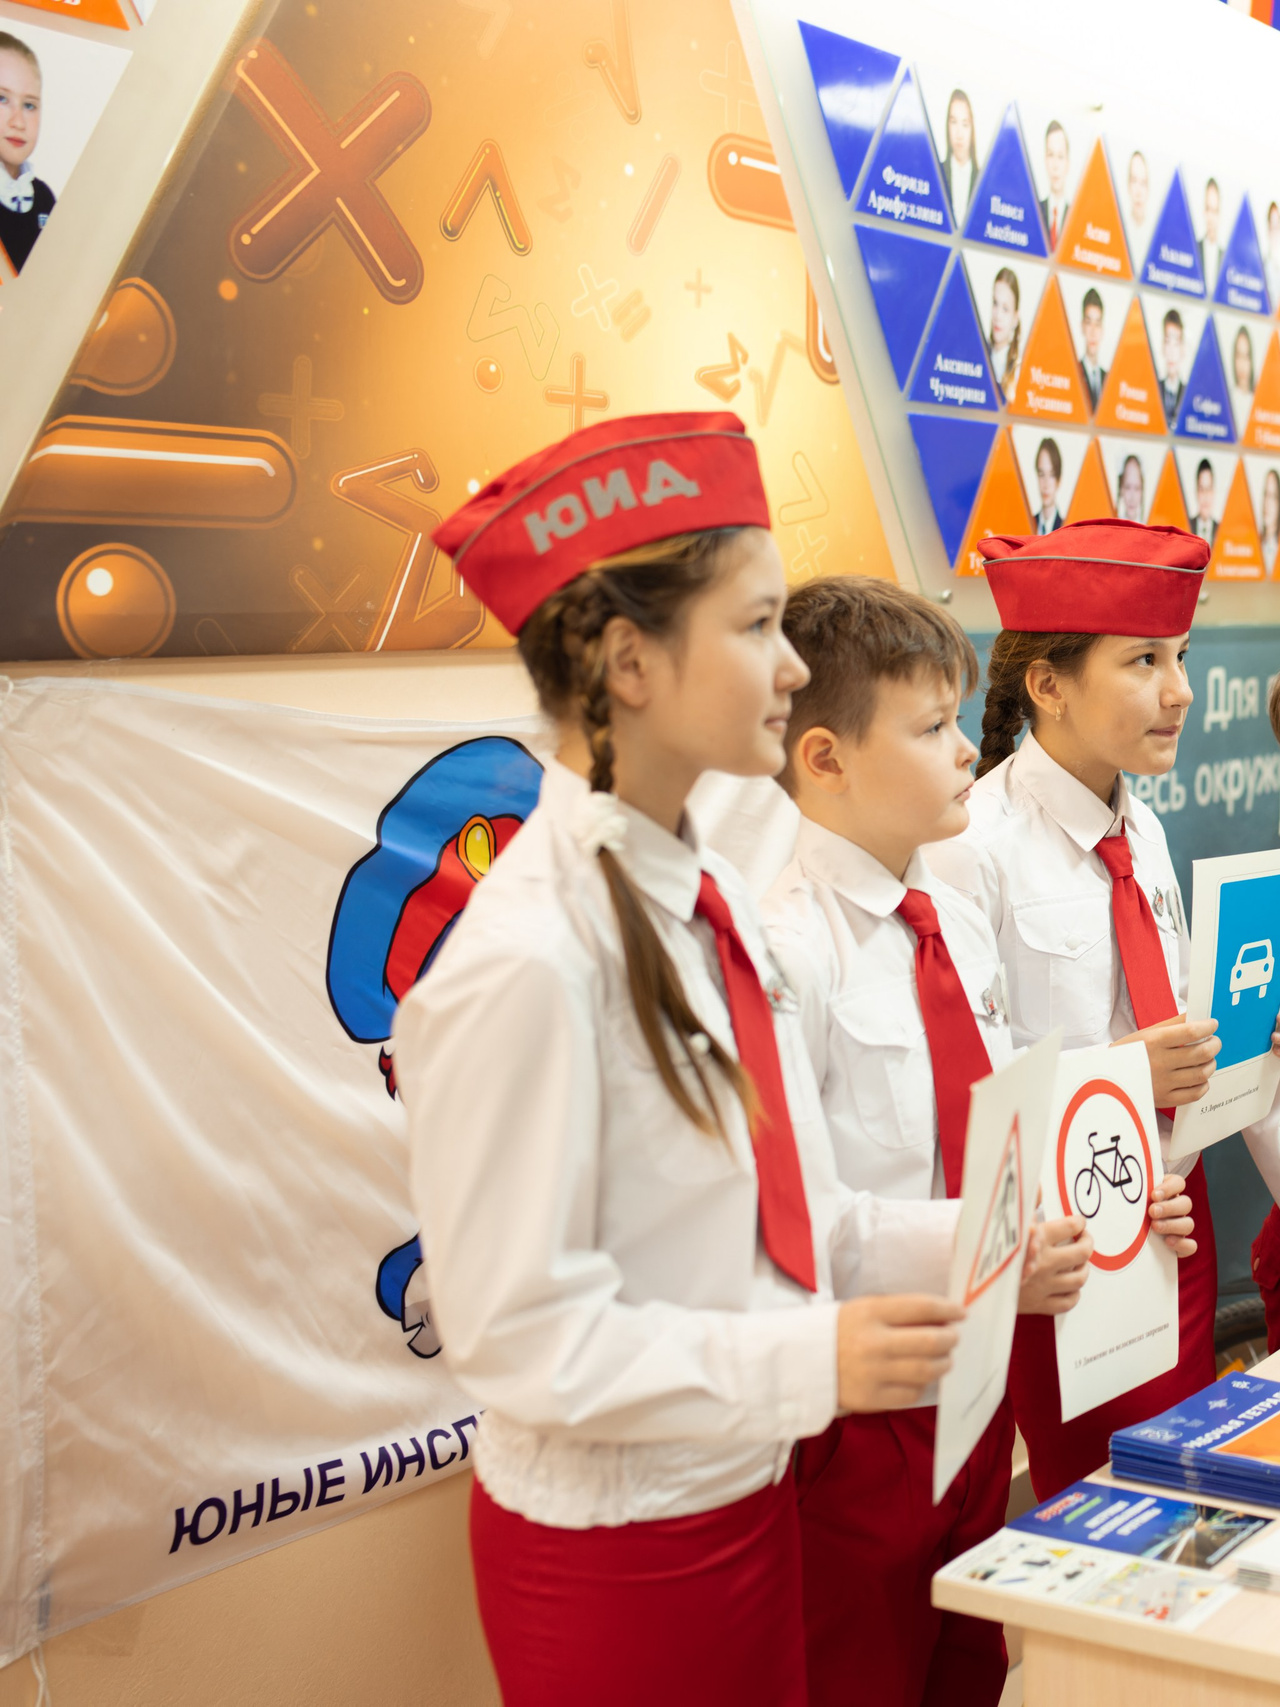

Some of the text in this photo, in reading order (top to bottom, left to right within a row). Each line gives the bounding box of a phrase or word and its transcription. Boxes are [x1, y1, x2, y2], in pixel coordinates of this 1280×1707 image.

[523, 459, 701, 555] ЮИД
[1203, 666, 1259, 733] Для
[1124, 769, 1186, 815] есь
[168, 1408, 488, 1555] ЮНЫЕ ИНСП
